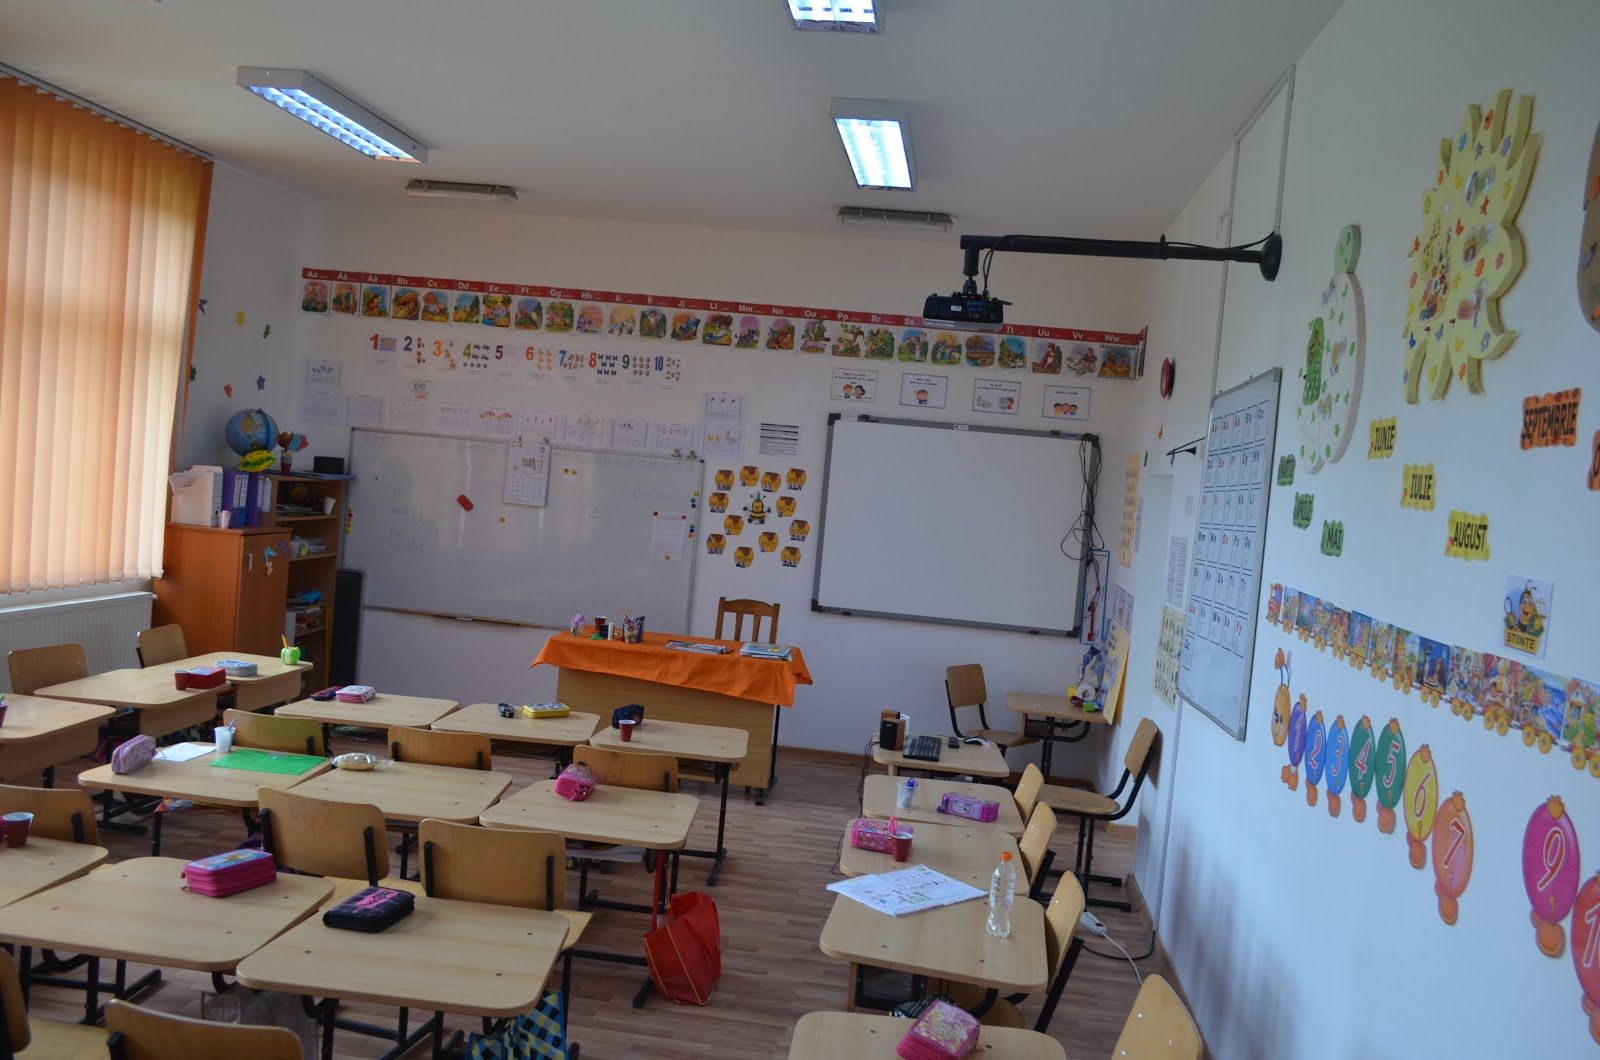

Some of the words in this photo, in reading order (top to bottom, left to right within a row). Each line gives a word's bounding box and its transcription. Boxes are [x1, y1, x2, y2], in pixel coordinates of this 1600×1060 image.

[308, 270, 318, 278] Aa
[397, 277, 408, 285] Bb
[428, 280, 438, 288] Cc
[458, 282, 470, 290] Dd
[772, 307, 784, 315] Nn
[804, 310, 817, 318] Oo
[872, 315, 881, 323] Rr
[1038, 328, 1050, 337] Uu
[1072, 331, 1084, 340] Vv
[370, 333, 380, 350] 1
[403, 336, 412, 352] 2
[433, 340, 442, 357] 3
[463, 342, 472, 360] 4
[496, 345, 504, 360] 5
[525, 346, 534, 360] 6
[560, 350, 567, 366] 7
[589, 352, 597, 368] 8
[622, 354, 630, 369] 9
[654, 356, 664, 371] 10
[1452, 522, 1488, 550] AUGUST
[1294, 716, 1302, 752] 1
[1308, 730, 1322, 770] 2
[1332, 736, 1344, 776] 3
[1354, 736, 1372, 780] 4
[1383, 740, 1400, 788] 5
[1414, 772, 1431, 818] 6
[1443, 819, 1466, 869] 7
[1537, 826, 1564, 891] 9
